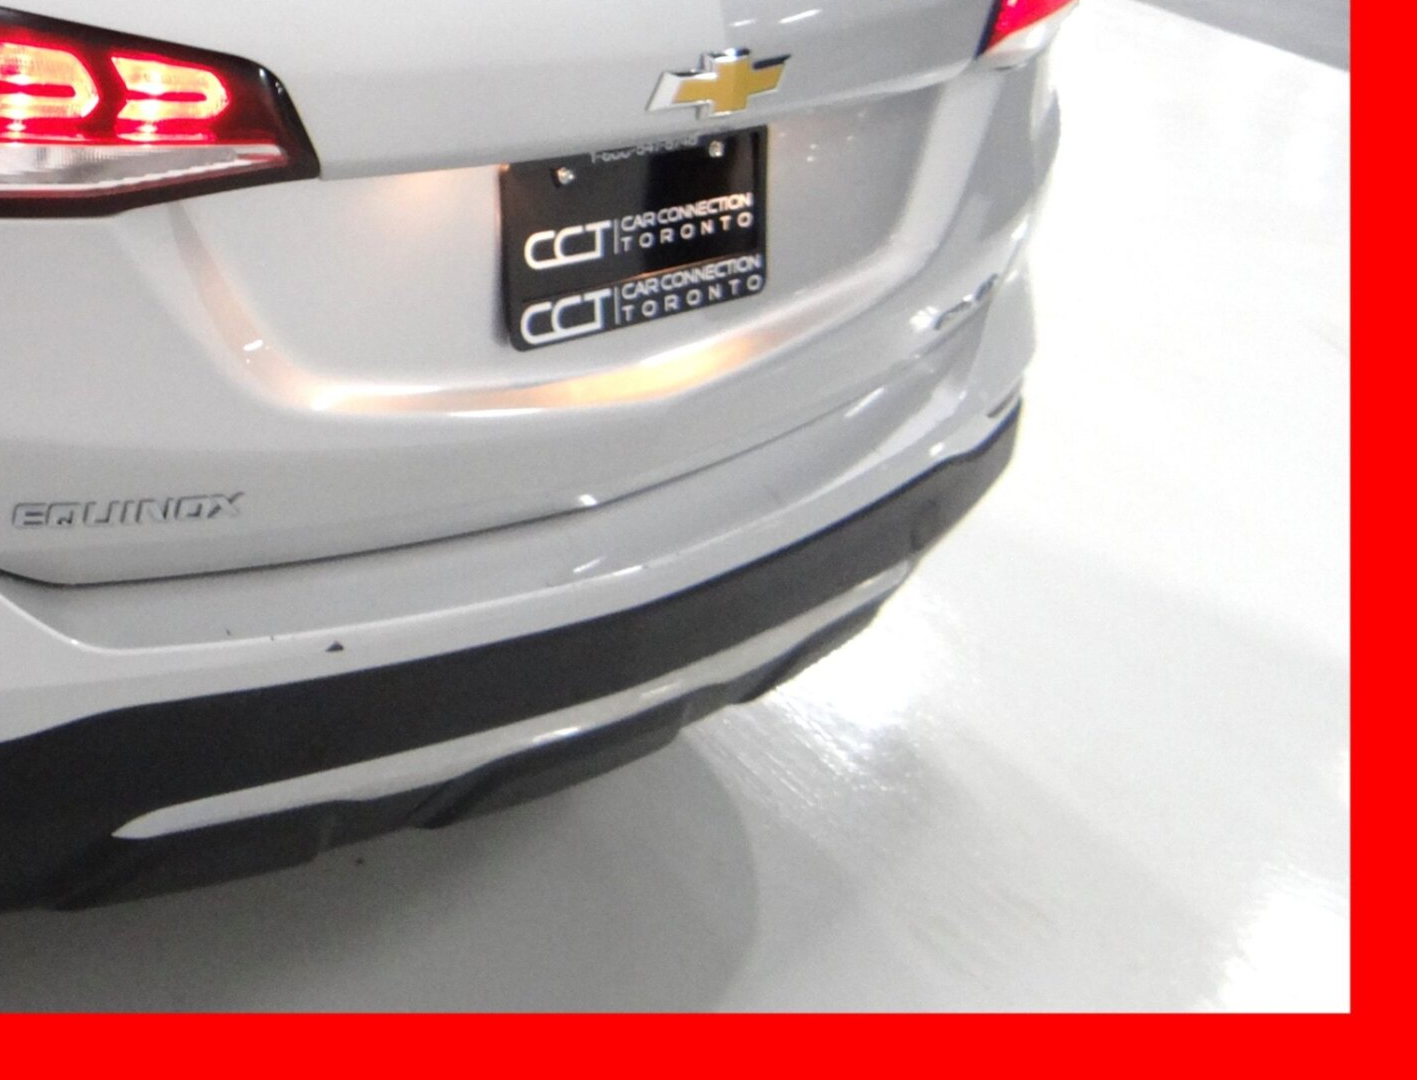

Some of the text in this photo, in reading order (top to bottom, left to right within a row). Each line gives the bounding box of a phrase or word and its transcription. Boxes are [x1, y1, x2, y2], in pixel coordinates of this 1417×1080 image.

[621, 192, 753, 232] CAR CONNECTION
[621, 211, 753, 252] TORONTO
[524, 220, 611, 270] CCT
[621, 253, 762, 300] CAR CONNECTION
[621, 273, 763, 321] TORONTO
[521, 288, 612, 345] CCT
[12, 491, 245, 529] EQUINOX
